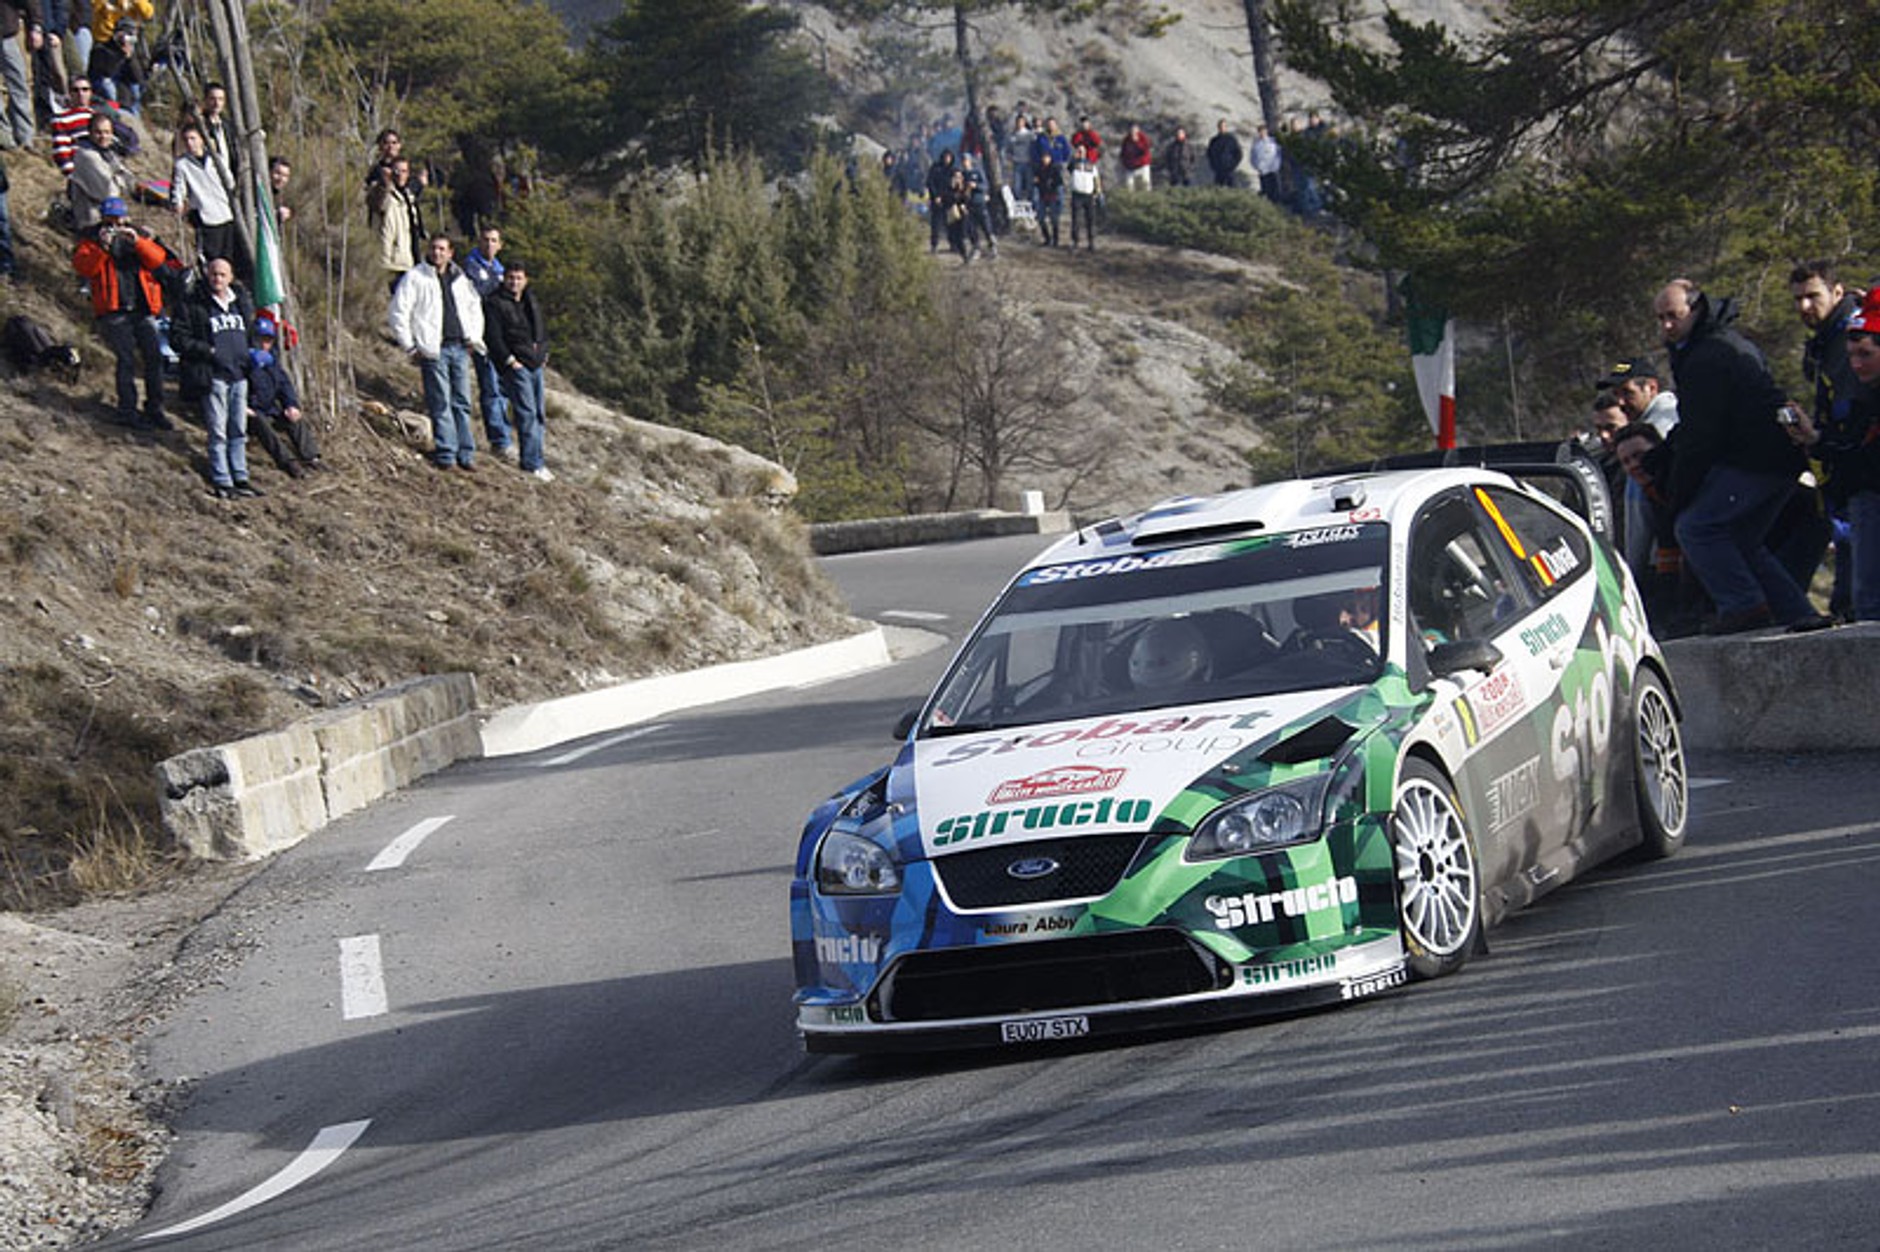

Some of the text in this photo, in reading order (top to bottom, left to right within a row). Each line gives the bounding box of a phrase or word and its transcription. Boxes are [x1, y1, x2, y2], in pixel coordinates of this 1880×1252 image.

[932, 708, 1272, 767] Stobart
[1076, 734, 1243, 758] Group
[984, 915, 1078, 936] Laura Abby
[1339, 962, 1408, 1000] PIRELLI
[1005, 1018, 1085, 1041] EU07 STX
